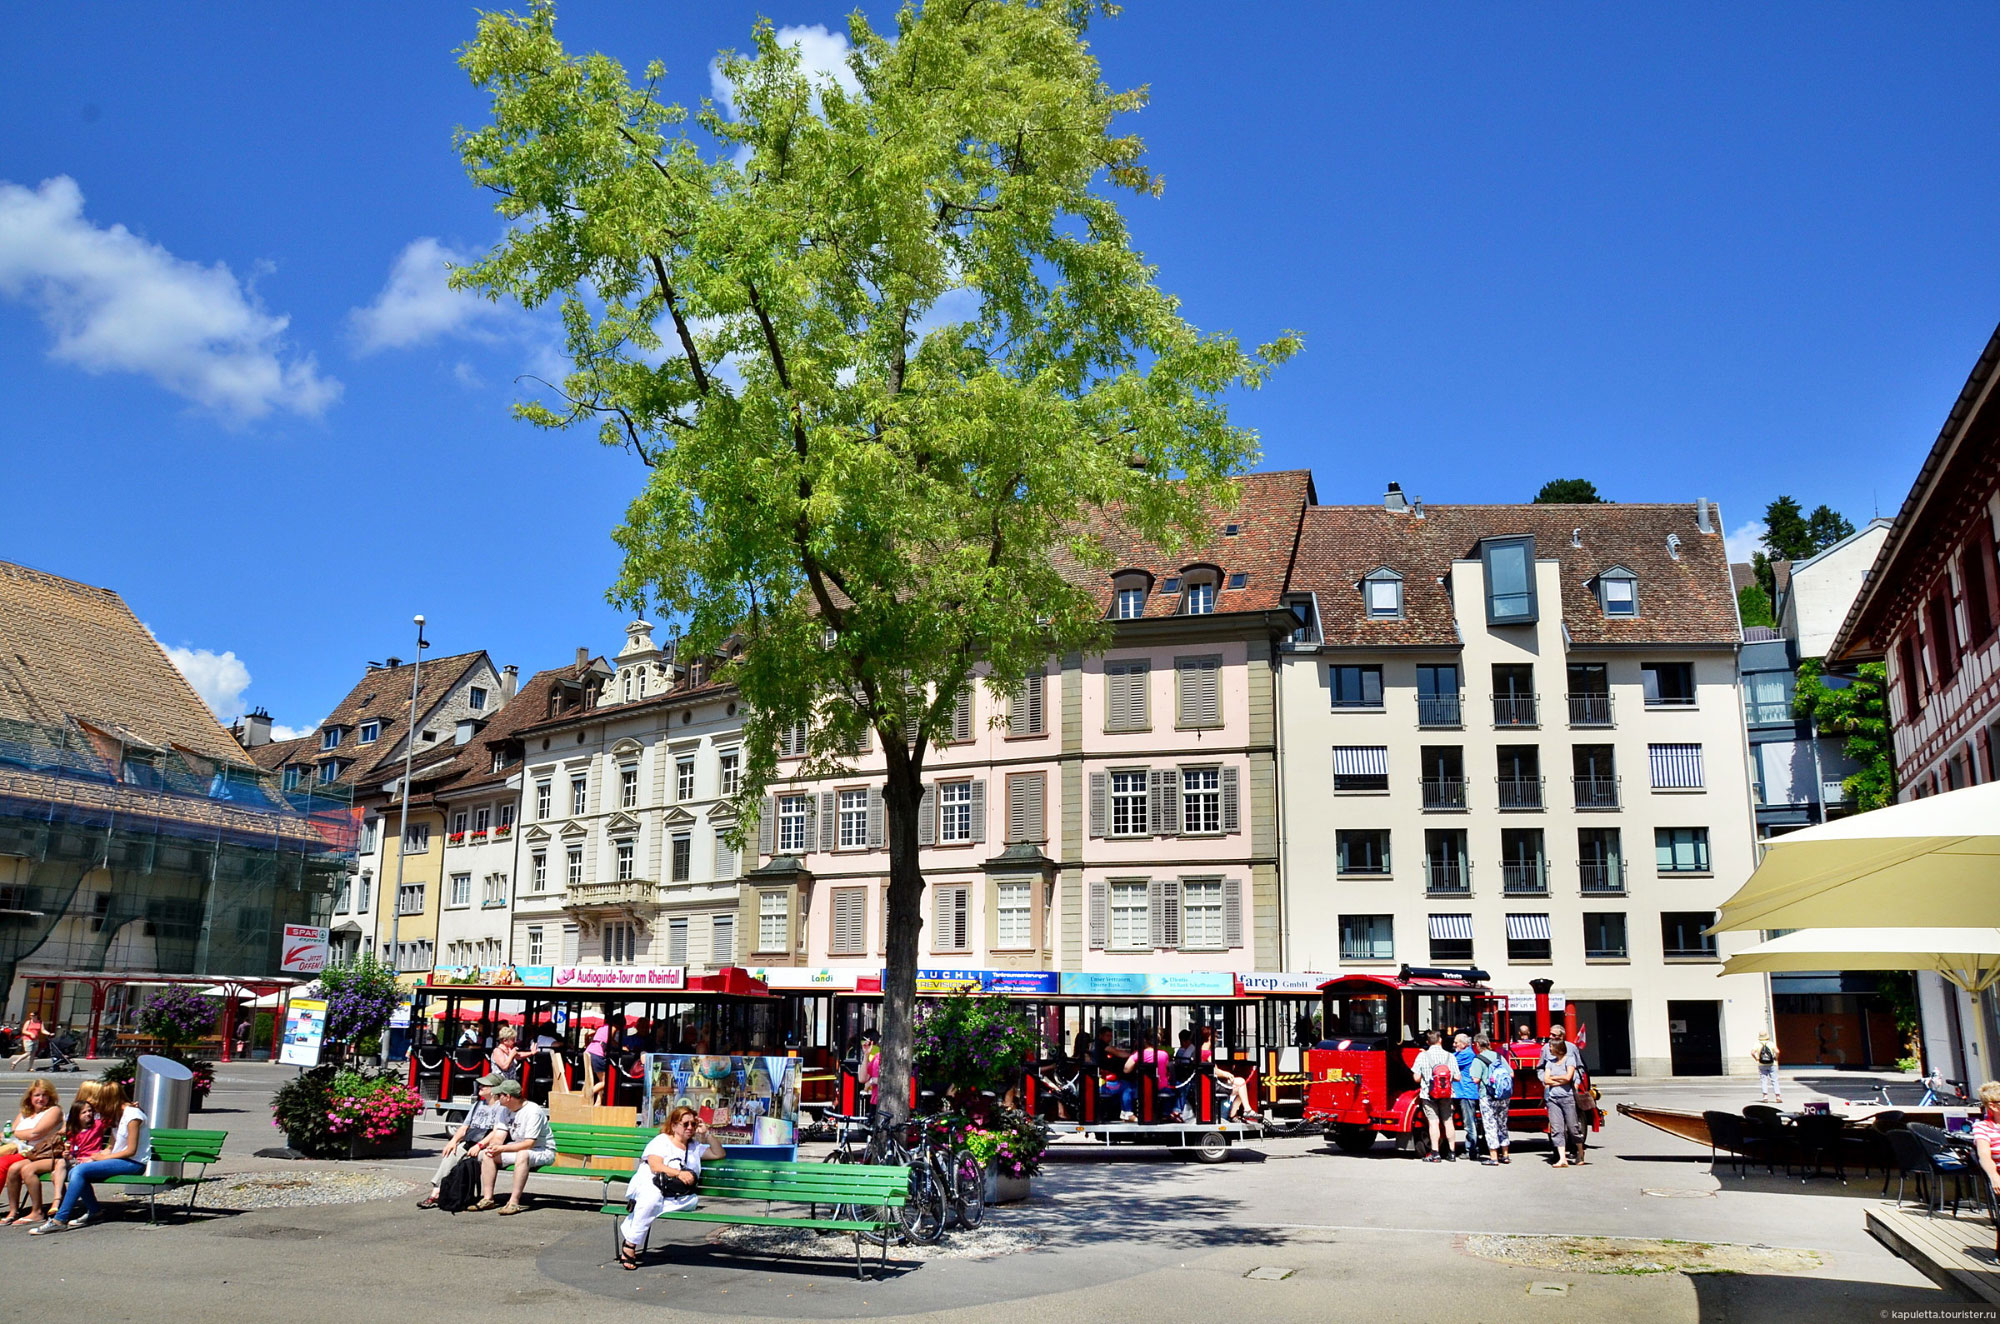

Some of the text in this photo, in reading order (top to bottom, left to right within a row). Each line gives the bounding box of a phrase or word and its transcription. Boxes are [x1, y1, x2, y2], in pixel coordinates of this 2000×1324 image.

[292, 928, 318, 937] SPAR
[298, 961, 324, 970] OFFEN!
[577, 969, 680, 987] Audioguide-Tour am Rheinfall
[811, 974, 833, 982] Landi
[917, 971, 982, 979] AUCHLI
[1240, 974, 1278, 990] farep
